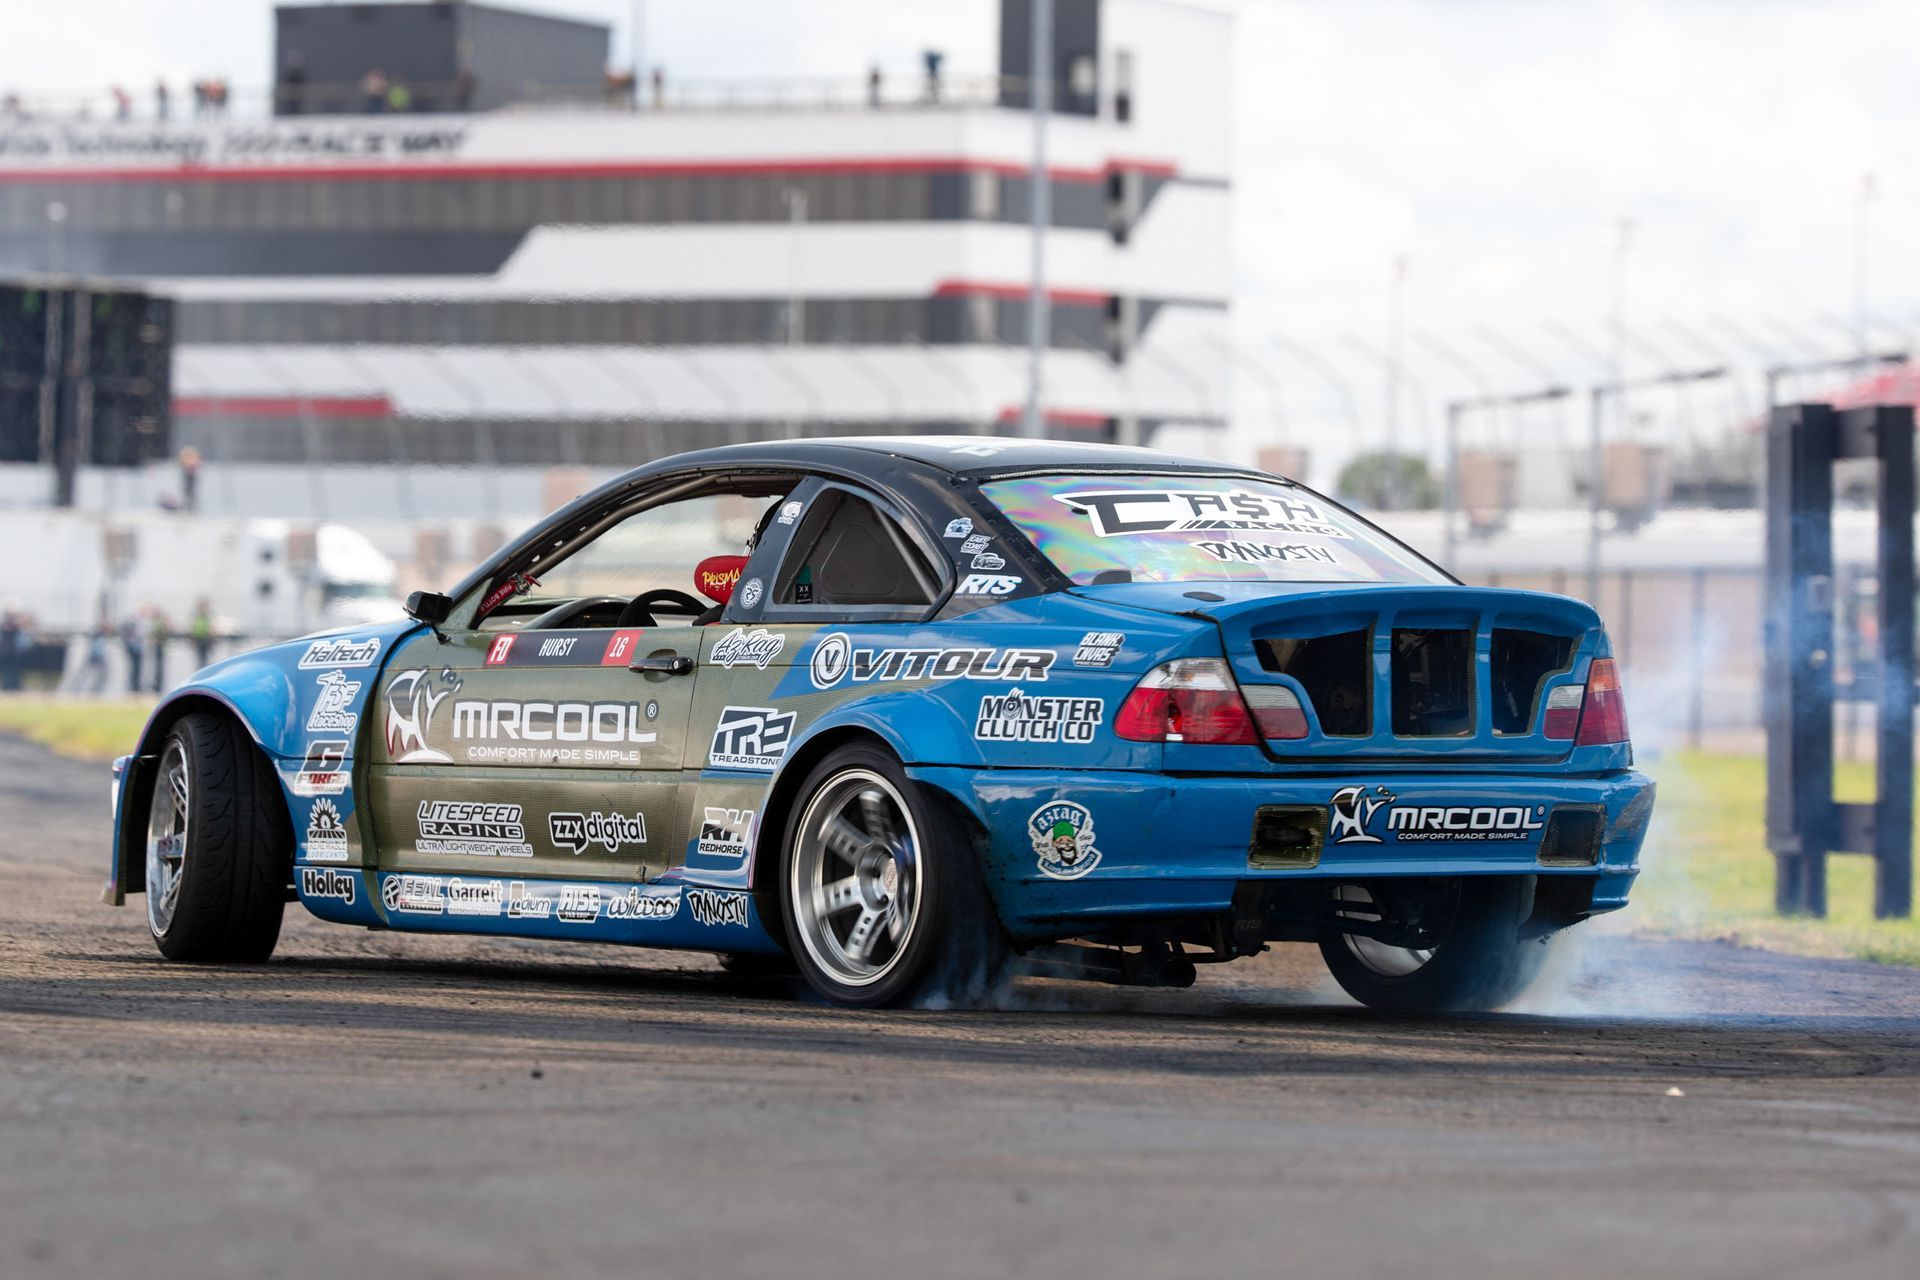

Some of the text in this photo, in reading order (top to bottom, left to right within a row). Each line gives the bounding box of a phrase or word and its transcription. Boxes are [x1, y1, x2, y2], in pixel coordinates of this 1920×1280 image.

[1226, 520, 1340, 537] RACING
[954, 574, 1022, 594] RTS
[303, 642, 377, 664] Haltech
[490, 636, 630, 662] FD HURST 16
[855, 651, 1054, 678] VITOUR
[980, 692, 1101, 721] MONSTER
[977, 719, 1093, 740] CLUTCH CO
[468, 746, 639, 761] COMFORT MADE SIMPLE
[711, 754, 782, 766] TREADSTONE
[419, 803, 521, 823] LITESPEED
[422, 822, 522, 838] RACING
[1397, 831, 1529, 841] COMFORT MADE SIMPLE
[417, 840, 444, 851] ULTRA
[496, 844, 532, 855] WHEELS
[699, 842, 744, 855] REDHORSE
[304, 871, 353, 902] Holley
[449, 879, 502, 903] Garrett
[560, 888, 599, 911] RISE
